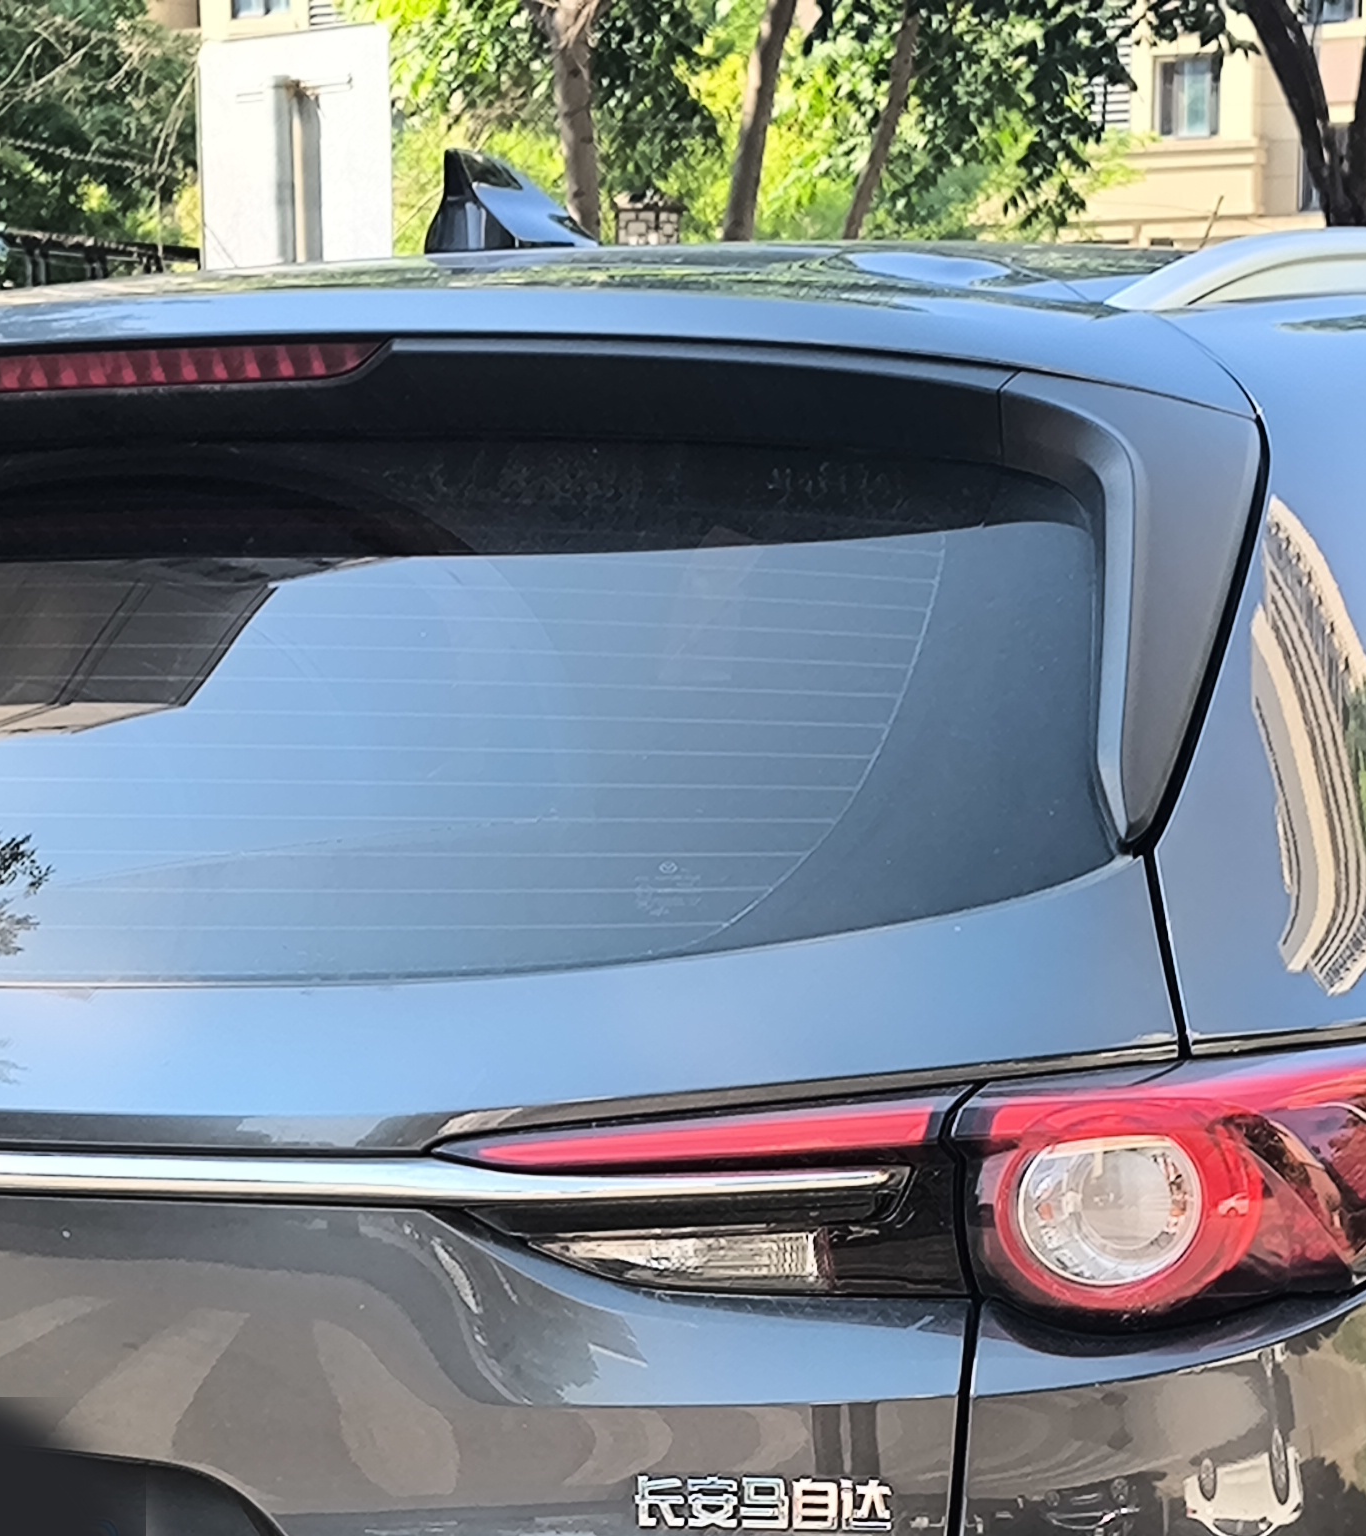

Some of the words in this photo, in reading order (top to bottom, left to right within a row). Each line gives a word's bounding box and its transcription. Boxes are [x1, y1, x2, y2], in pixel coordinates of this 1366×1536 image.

[634, 1475, 892, 1531] 长安马自达
